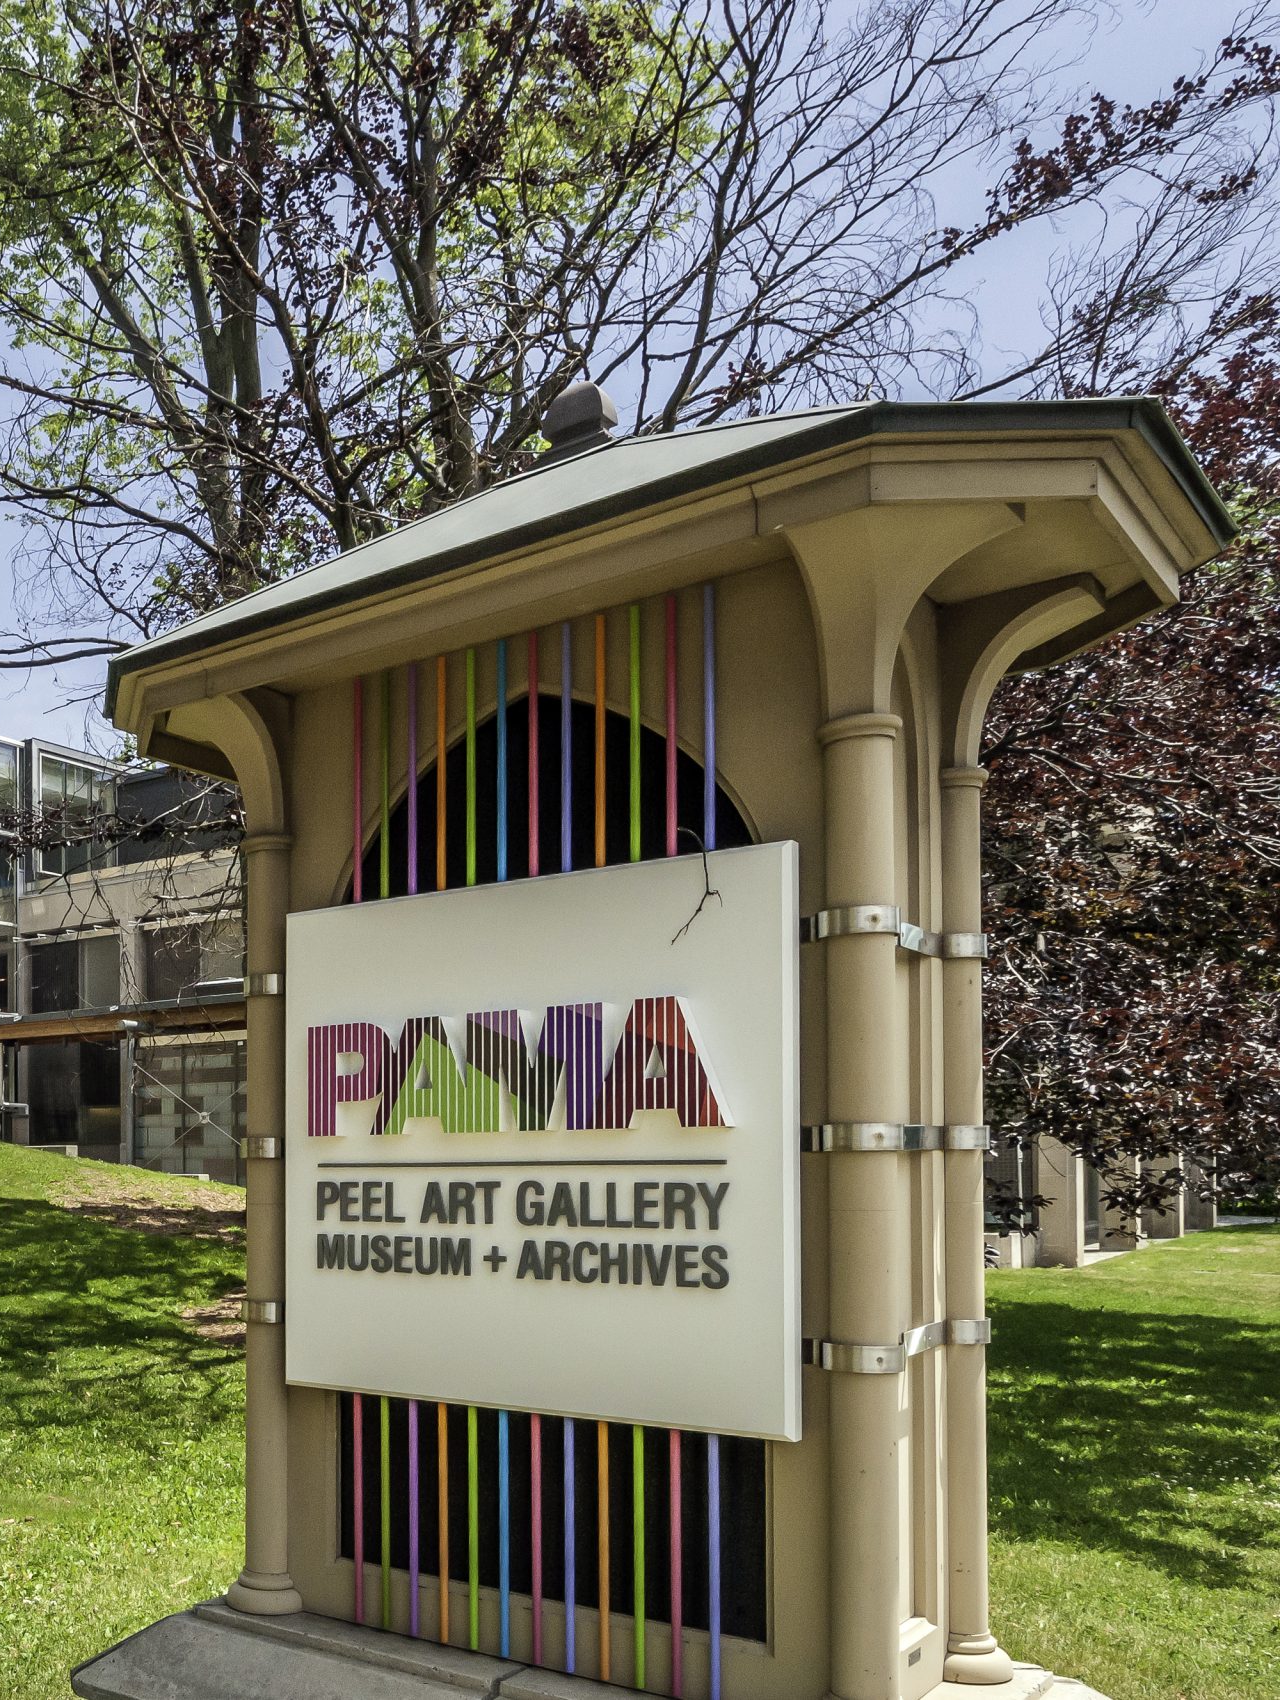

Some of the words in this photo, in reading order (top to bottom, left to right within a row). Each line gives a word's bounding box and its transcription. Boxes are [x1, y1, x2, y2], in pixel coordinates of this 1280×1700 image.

[307, 996, 734, 1137] PAMA
[316, 1180, 406, 1223] PEEL
[420, 1181, 501, 1224] ART
[515, 1180, 730, 1230] GALLERY
[316, 1233, 472, 1276] MUSEUM
[483, 1245, 508, 1273] +
[516, 1239, 730, 1290] ARCHIVES
